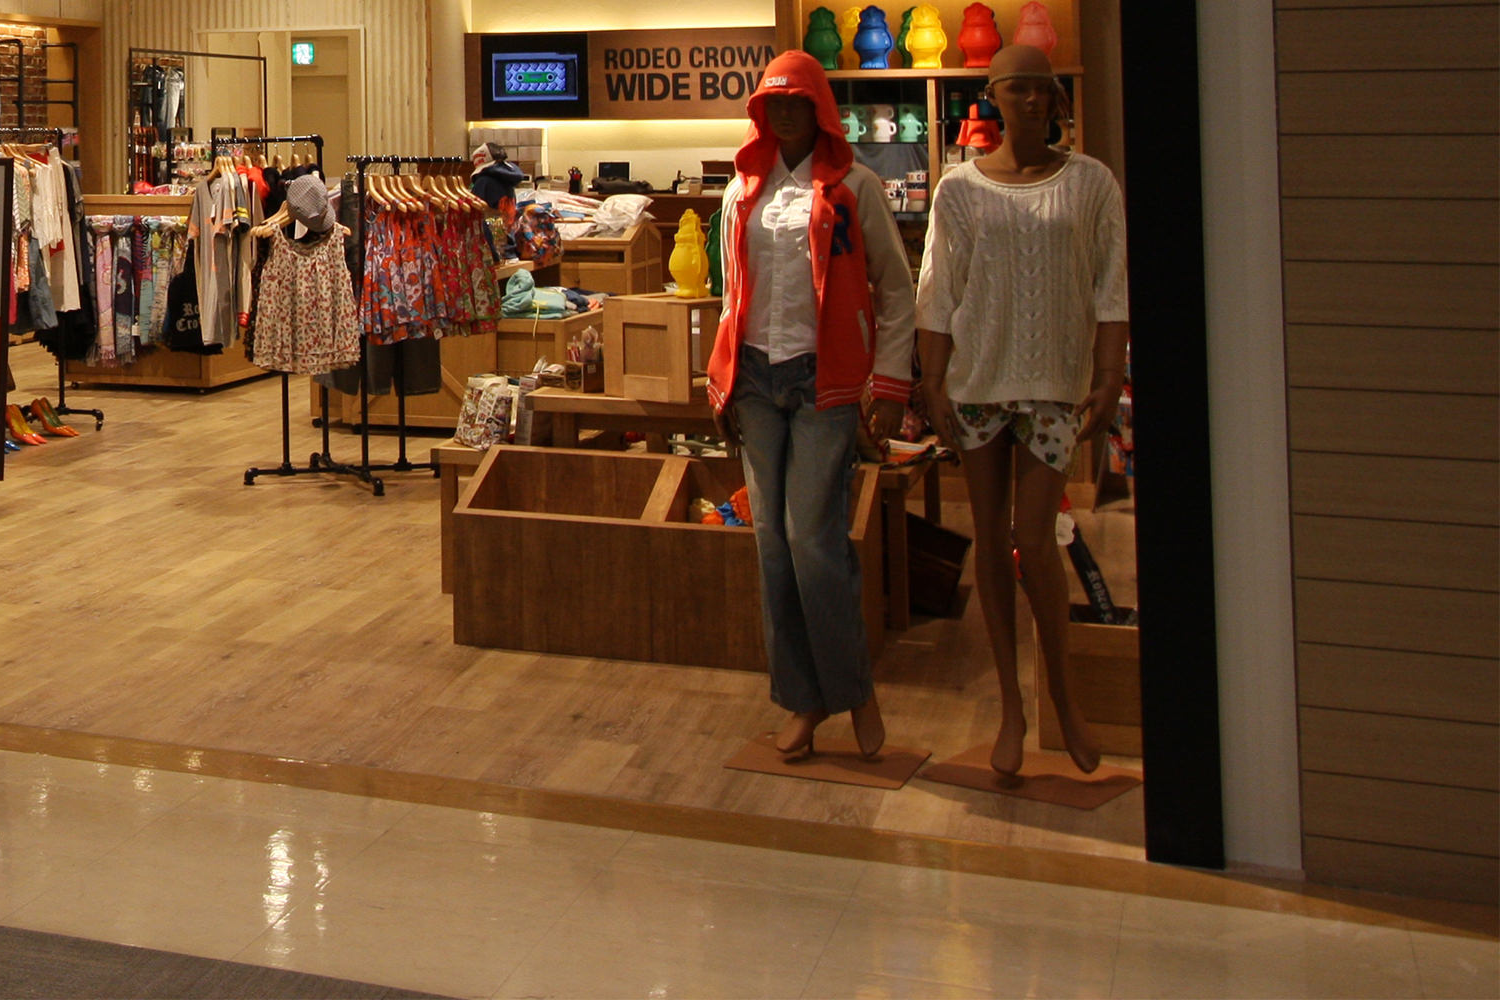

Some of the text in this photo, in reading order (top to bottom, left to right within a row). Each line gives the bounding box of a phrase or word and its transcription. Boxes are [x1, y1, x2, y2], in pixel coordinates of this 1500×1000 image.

[604, 46, 777, 70] RODEO CROWN
[605, 72, 691, 101] WIDE
[175, 318, 199, 332] Cro
